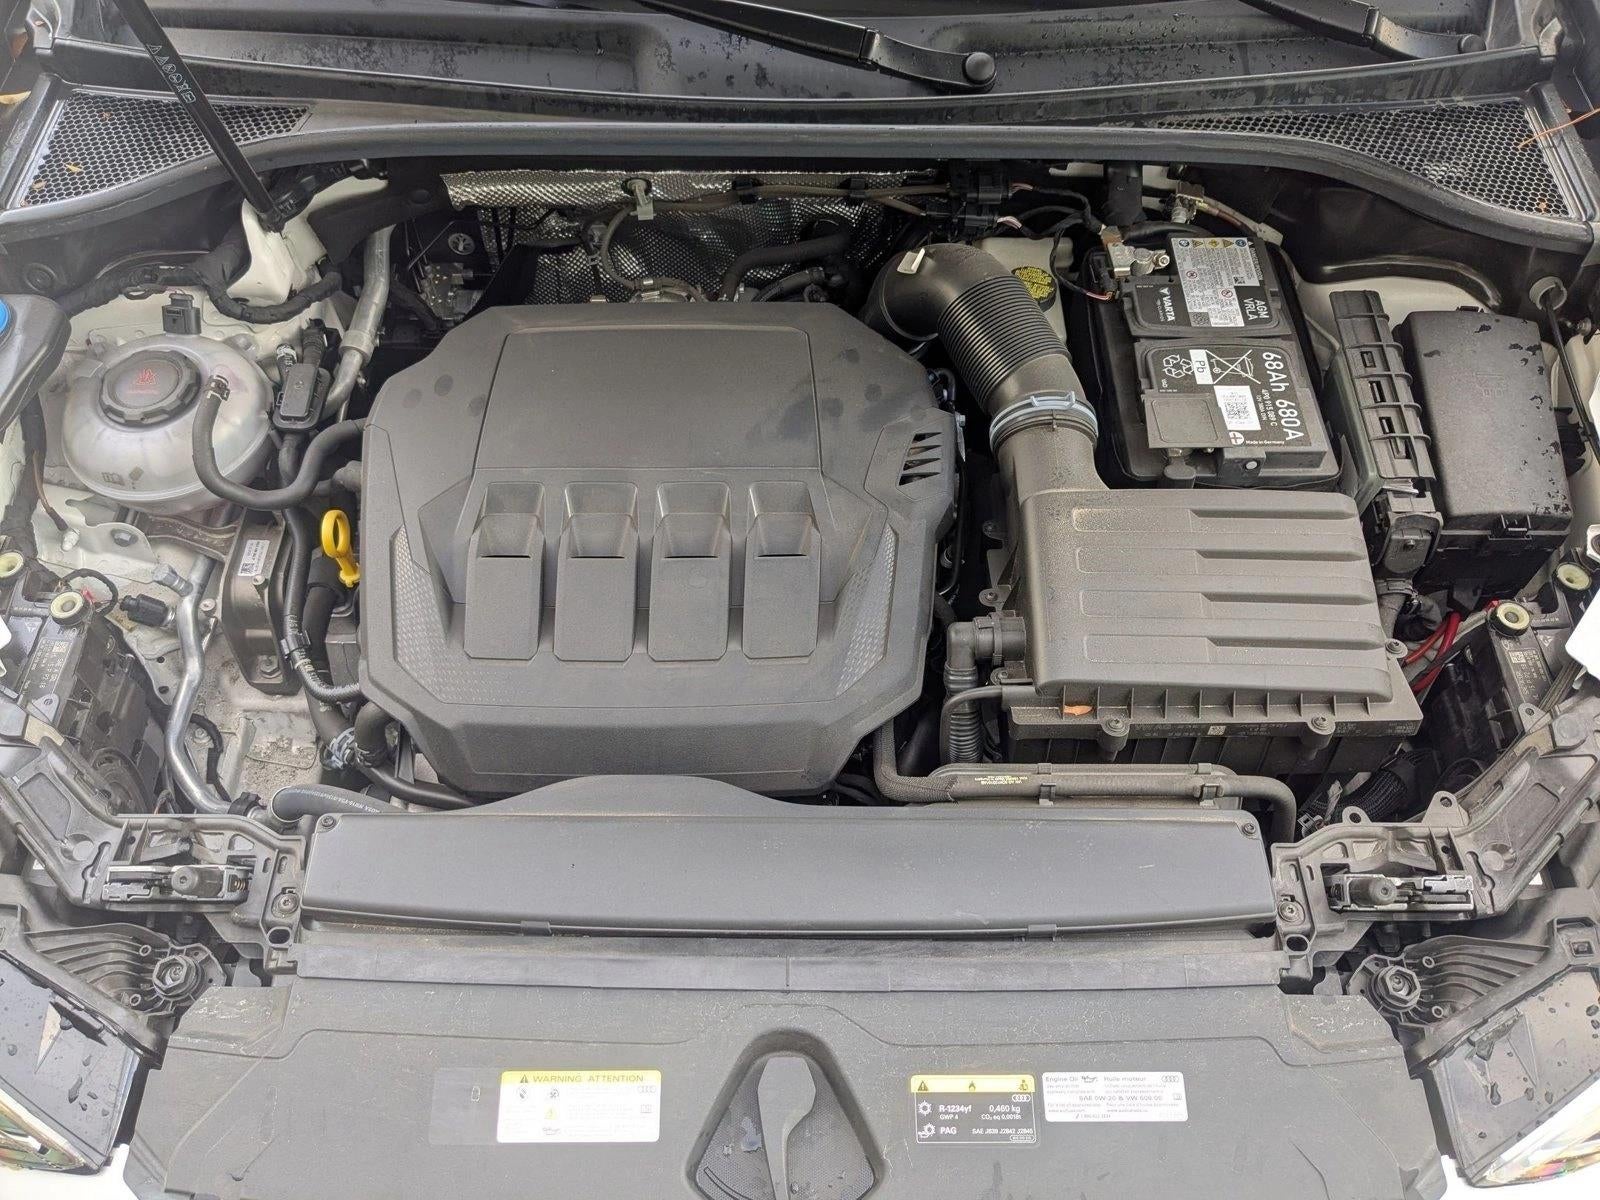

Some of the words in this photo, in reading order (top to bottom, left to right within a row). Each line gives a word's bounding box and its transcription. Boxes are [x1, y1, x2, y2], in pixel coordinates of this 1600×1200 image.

[1163, 296, 1175, 321] VARTA
[1244, 298, 1257, 320] VRLA
[1255, 300, 1269, 318] AGM
[1195, 360, 1205, 373] Pb
[1262, 352, 1289, 392] 68Ah
[1275, 399, 1305, 440] 680A
[532, 1074, 583, 1083] WARNING
[587, 1074, 645, 1083] ATTENTION
[939, 1104, 972, 1114] R-1234yf
[1011, 1105, 1021, 1113] kg
[940, 1126, 957, 1135] PAG
